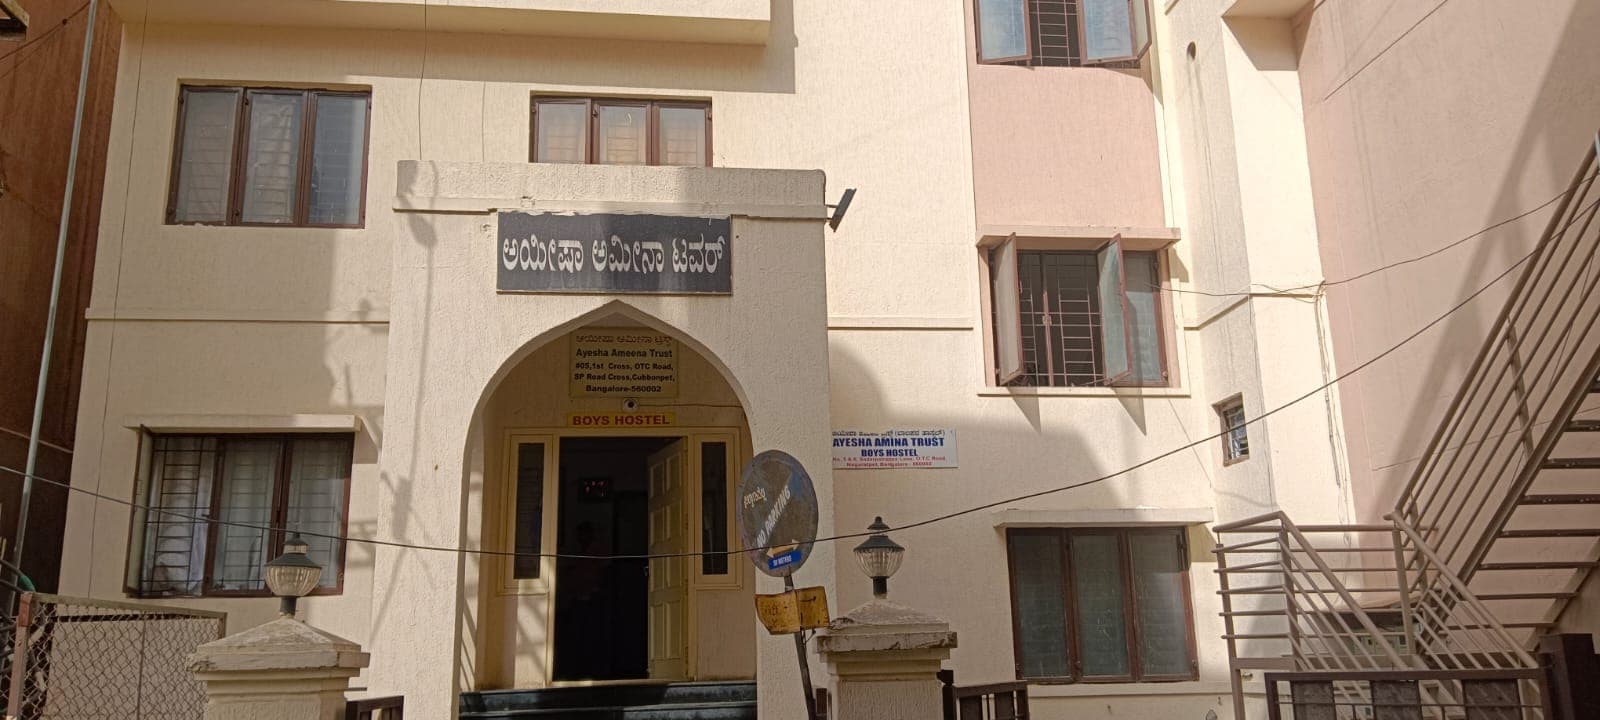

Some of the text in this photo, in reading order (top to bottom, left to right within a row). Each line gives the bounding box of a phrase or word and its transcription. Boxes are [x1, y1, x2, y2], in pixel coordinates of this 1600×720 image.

[502, 233, 726, 274] ಅಯೀಷಾ ಅಮೀನಾ ಟವರ್
[576, 348, 673, 358] Ayesha Ameena Trust
[575, 362, 604, 370] #05,1st
[608, 363, 633, 371] Cross,
[653, 363, 674, 371] Road,
[572, 415, 670, 425] BOYS HOSTEL
[832, 437, 944, 447] AYESHA AMINA TRUST
[861, 448, 919, 457] BOYS HOSTEL
[765, 485, 791, 536] PARKING
